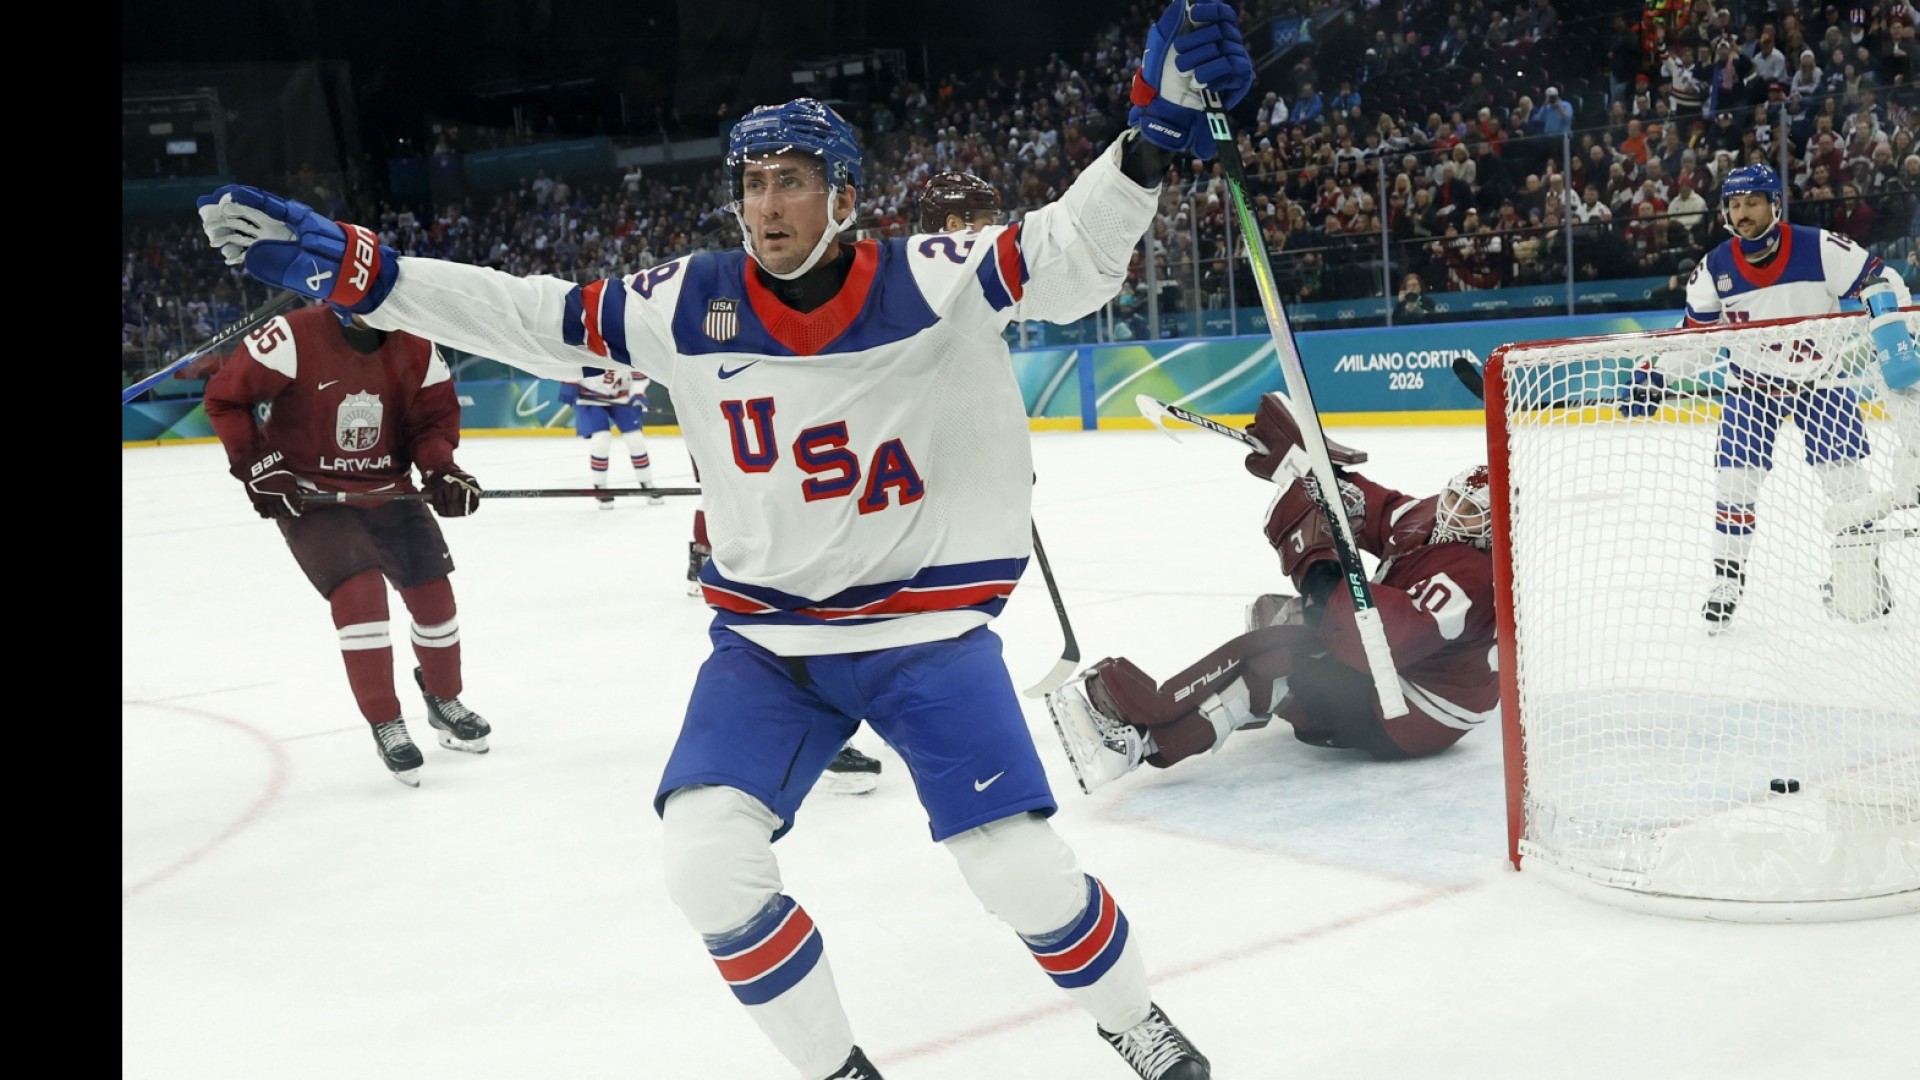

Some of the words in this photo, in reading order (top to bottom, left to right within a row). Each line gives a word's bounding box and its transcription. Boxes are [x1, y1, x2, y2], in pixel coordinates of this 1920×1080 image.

[712, 301, 733, 311] USA
[1333, 352, 1403, 373] MILANO
[1389, 371, 1424, 390] 2026
[319, 455, 391, 472] LATVIJA
[719, 396, 925, 515] USA
[1173, 658, 1241, 703] TRUE
